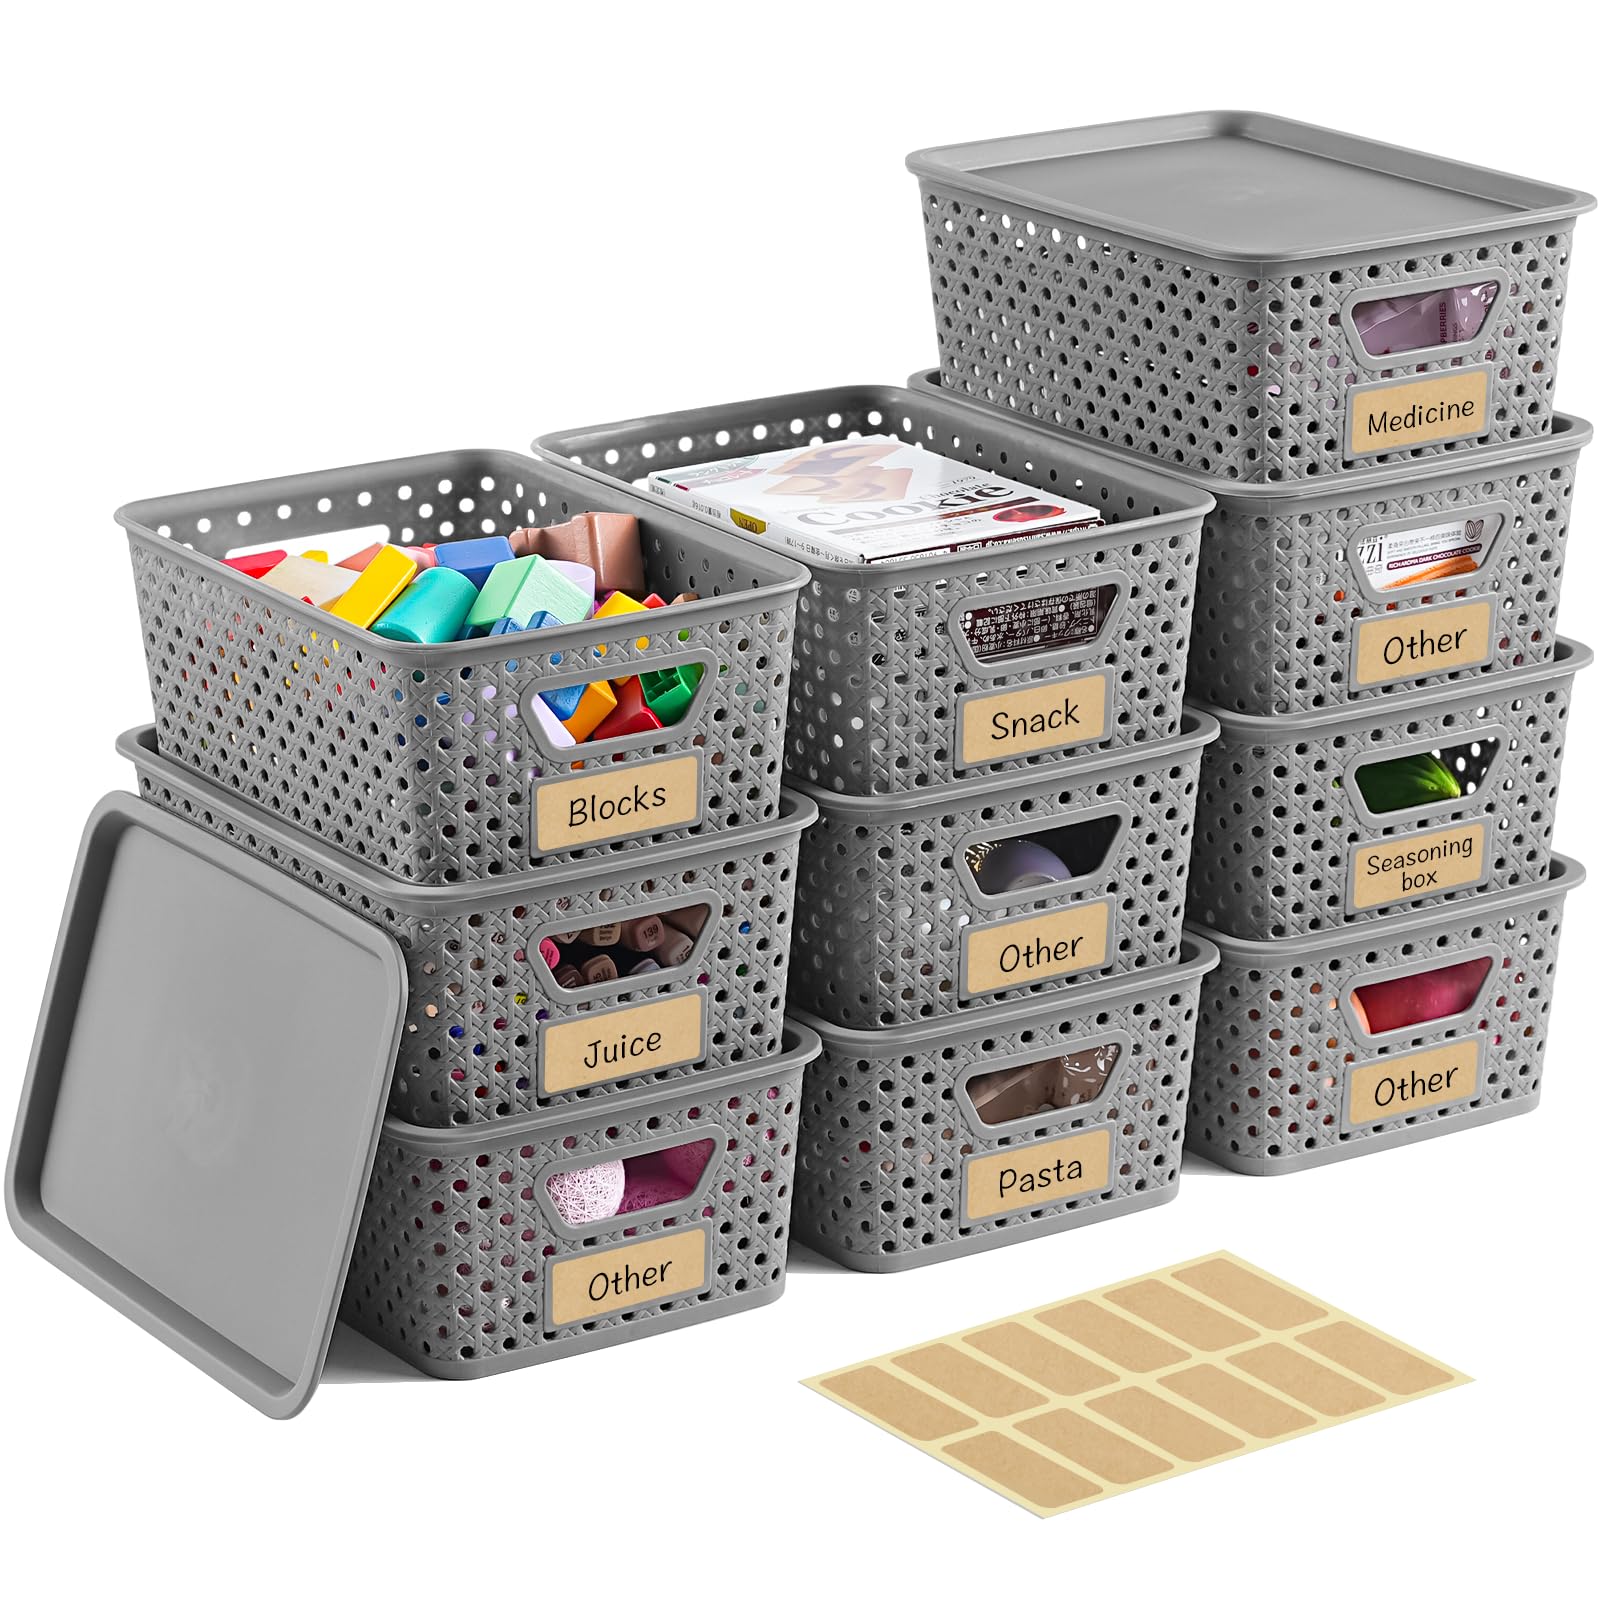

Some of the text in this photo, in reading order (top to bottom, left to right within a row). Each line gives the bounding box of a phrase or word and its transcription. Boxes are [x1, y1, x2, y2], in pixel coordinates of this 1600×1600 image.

[1368, 400, 1474, 435] Medicine
[738, 516, 758, 533] OPEN
[797, 485, 1014, 527] Cookie
[1383, 628, 1468, 665] Other
[991, 697, 1080, 740] Snack
[568, 784, 666, 828] Blocks
[1367, 837, 1473, 876] Seasoning
[1402, 869, 1438, 892] box
[643, 924, 659, 939] 139
[999, 936, 1084, 973] Other
[583, 1032, 662, 1069] Juice
[1374, 1067, 1459, 1107] Other
[999, 1159, 1082, 1199] Pasta
[588, 1260, 673, 1302] Other
